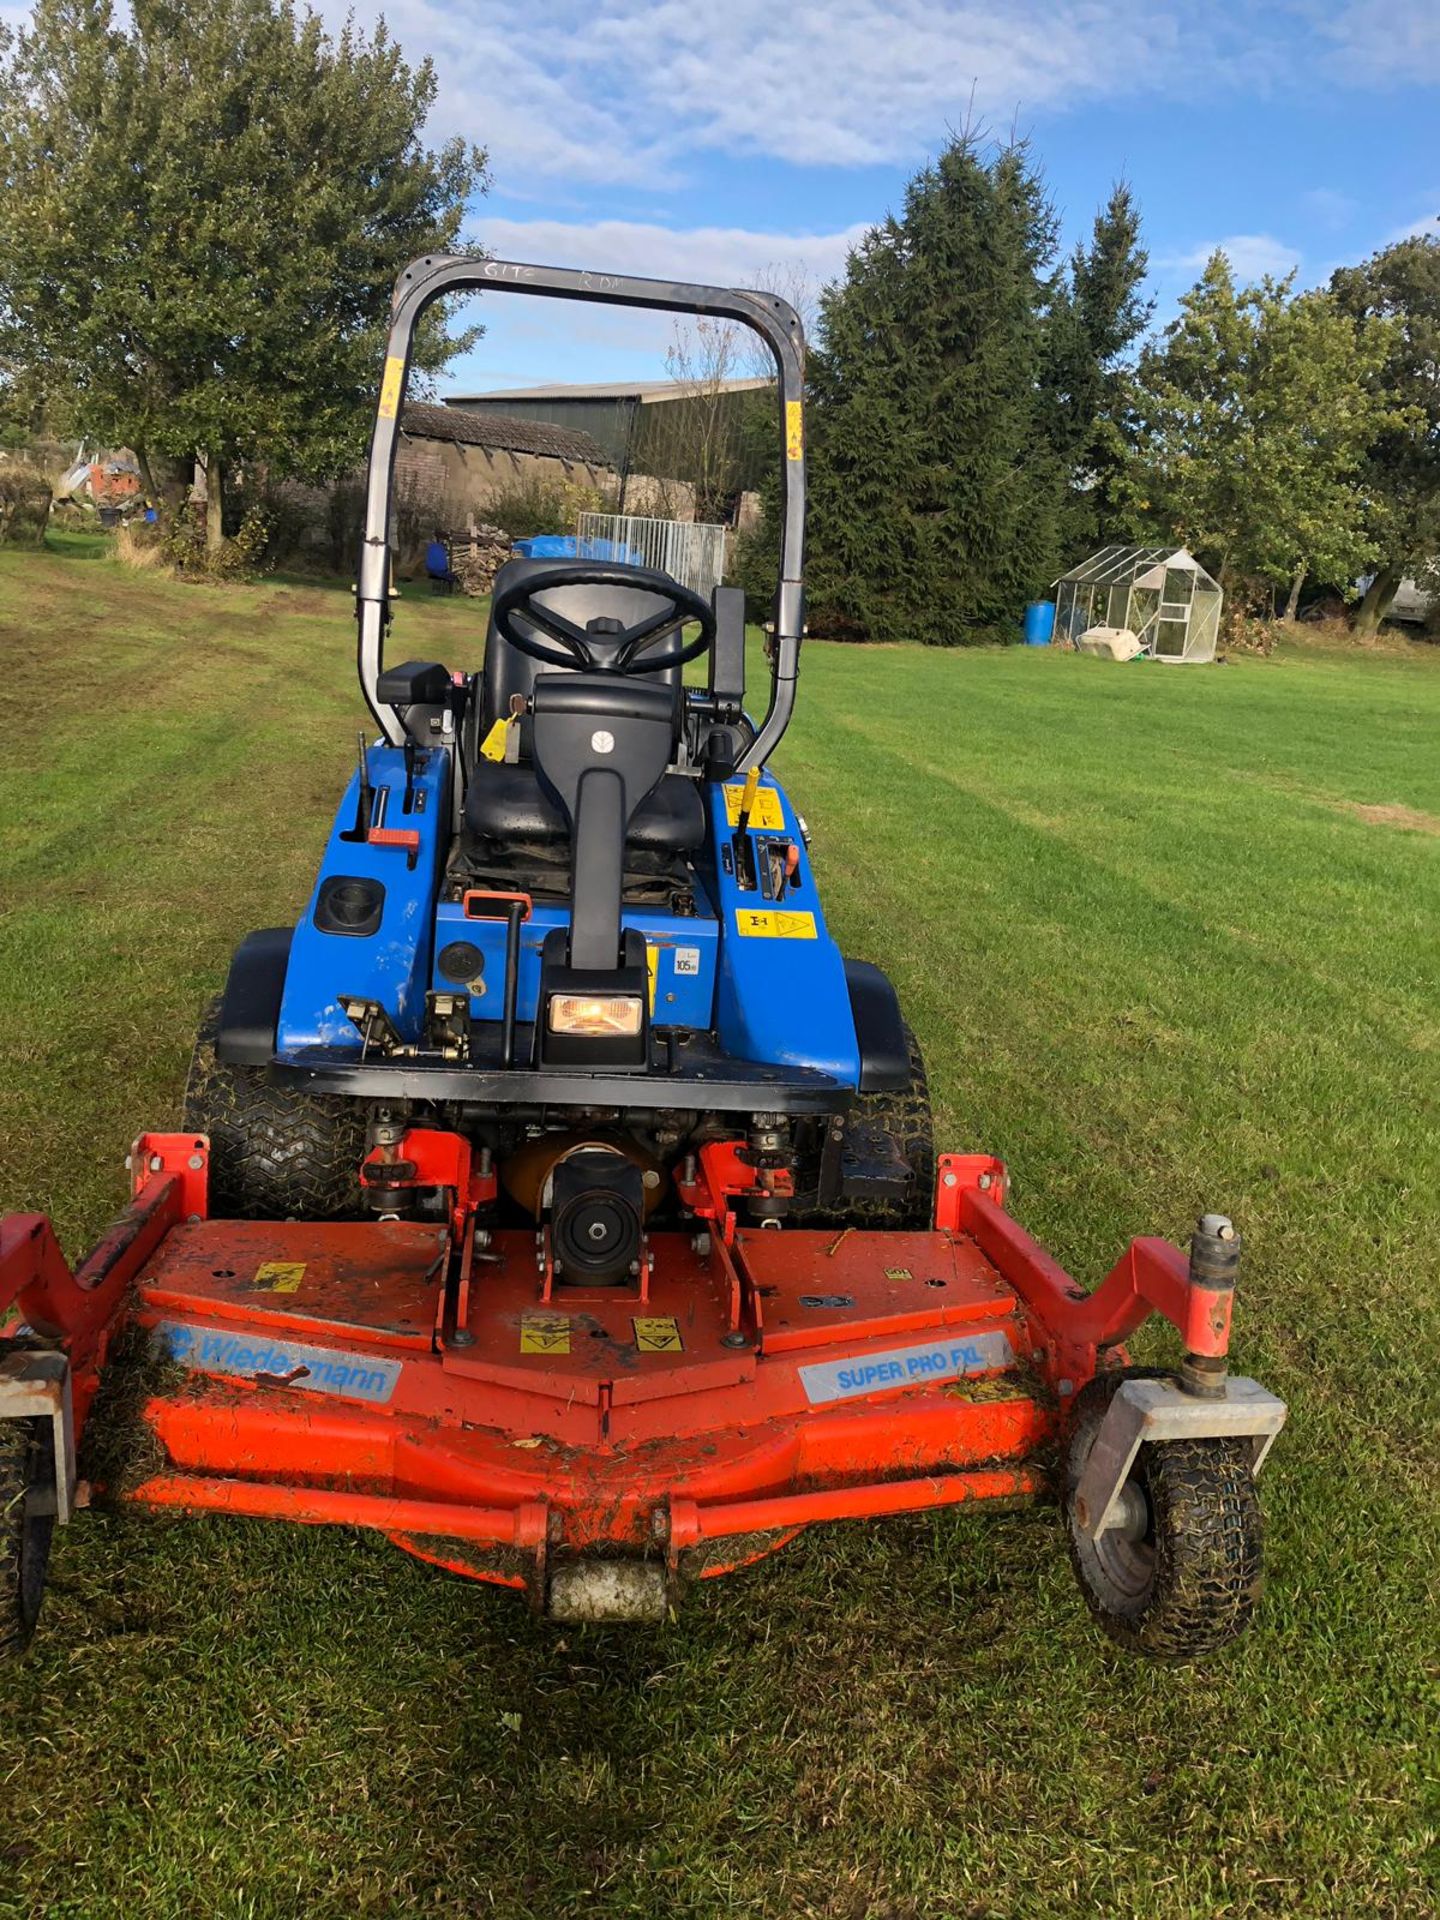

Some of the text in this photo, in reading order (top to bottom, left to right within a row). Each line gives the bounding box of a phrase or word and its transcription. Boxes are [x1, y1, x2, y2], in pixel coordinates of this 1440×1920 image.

[837, 1345, 984, 1389] SUPER PRO FXL
